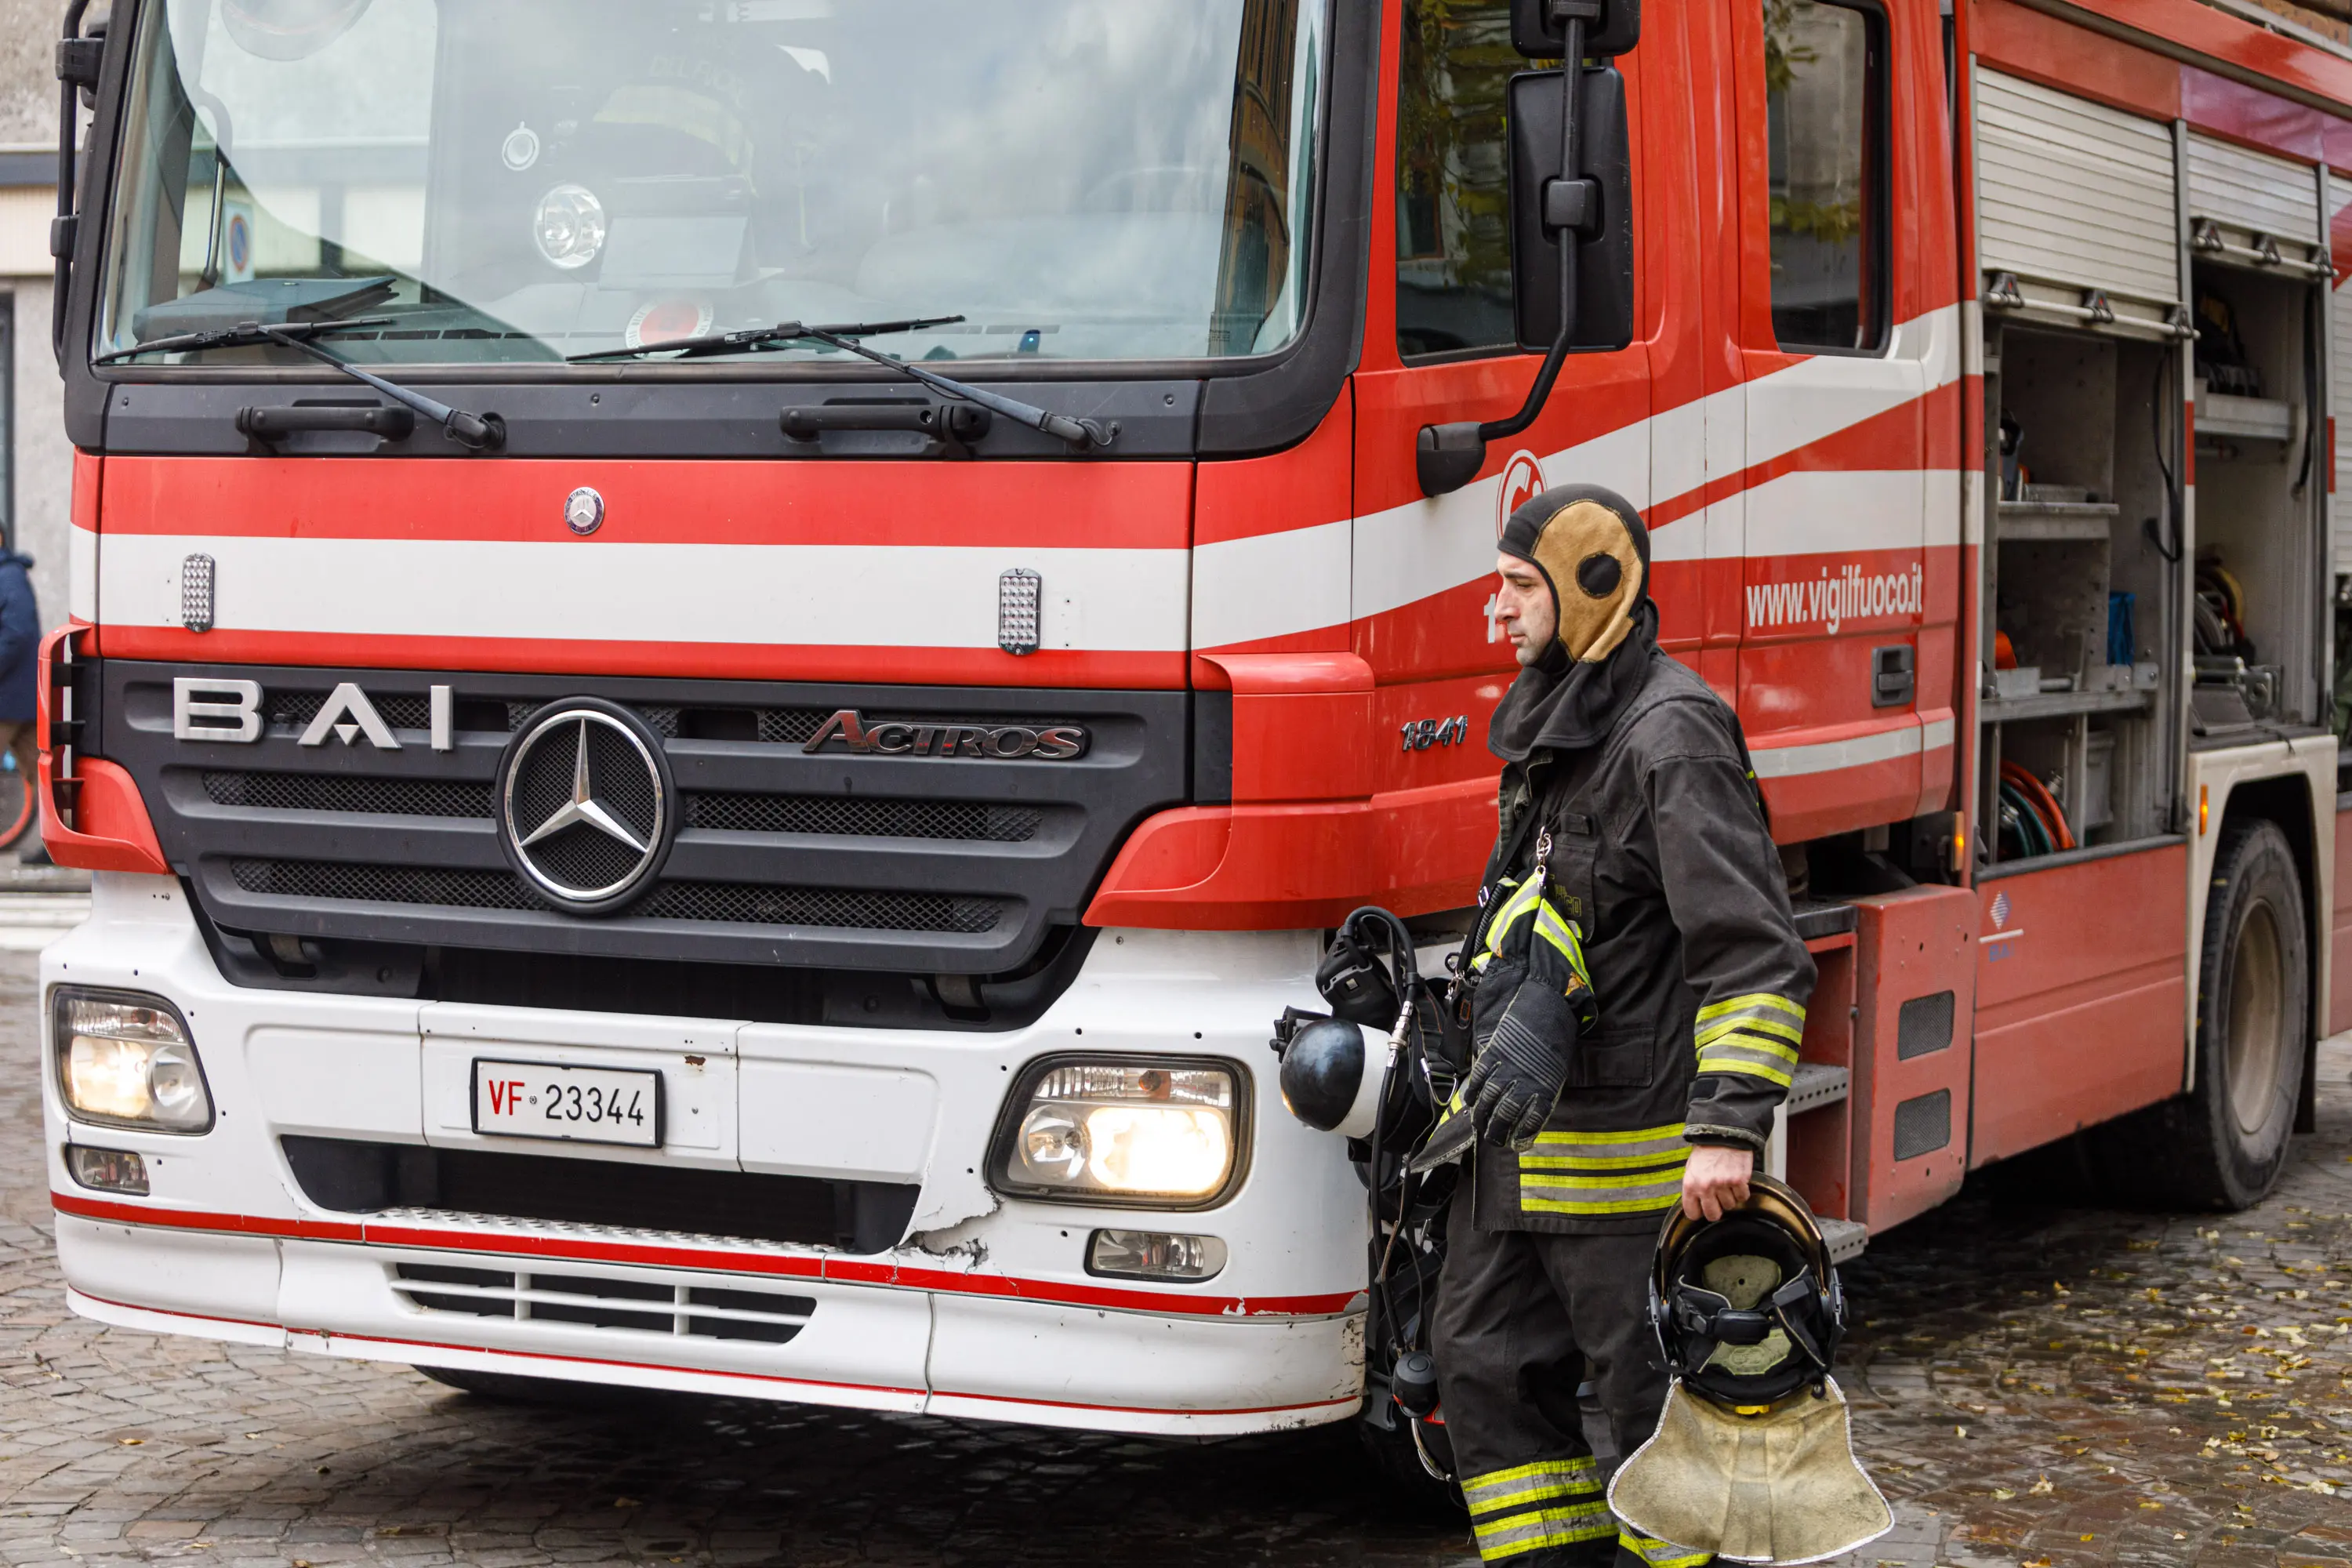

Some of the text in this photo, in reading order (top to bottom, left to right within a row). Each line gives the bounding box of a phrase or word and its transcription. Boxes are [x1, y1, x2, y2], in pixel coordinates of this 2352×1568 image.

[1746, 562, 1922, 634] www.vigilfuoco.it
[173, 677, 454, 751] BAI
[802, 709, 1084, 760] ACTROS
[1400, 714, 1468, 751] 1841
[1988, 941, 2016, 963] BAI
[488, 1080, 644, 1126] VF 23344
